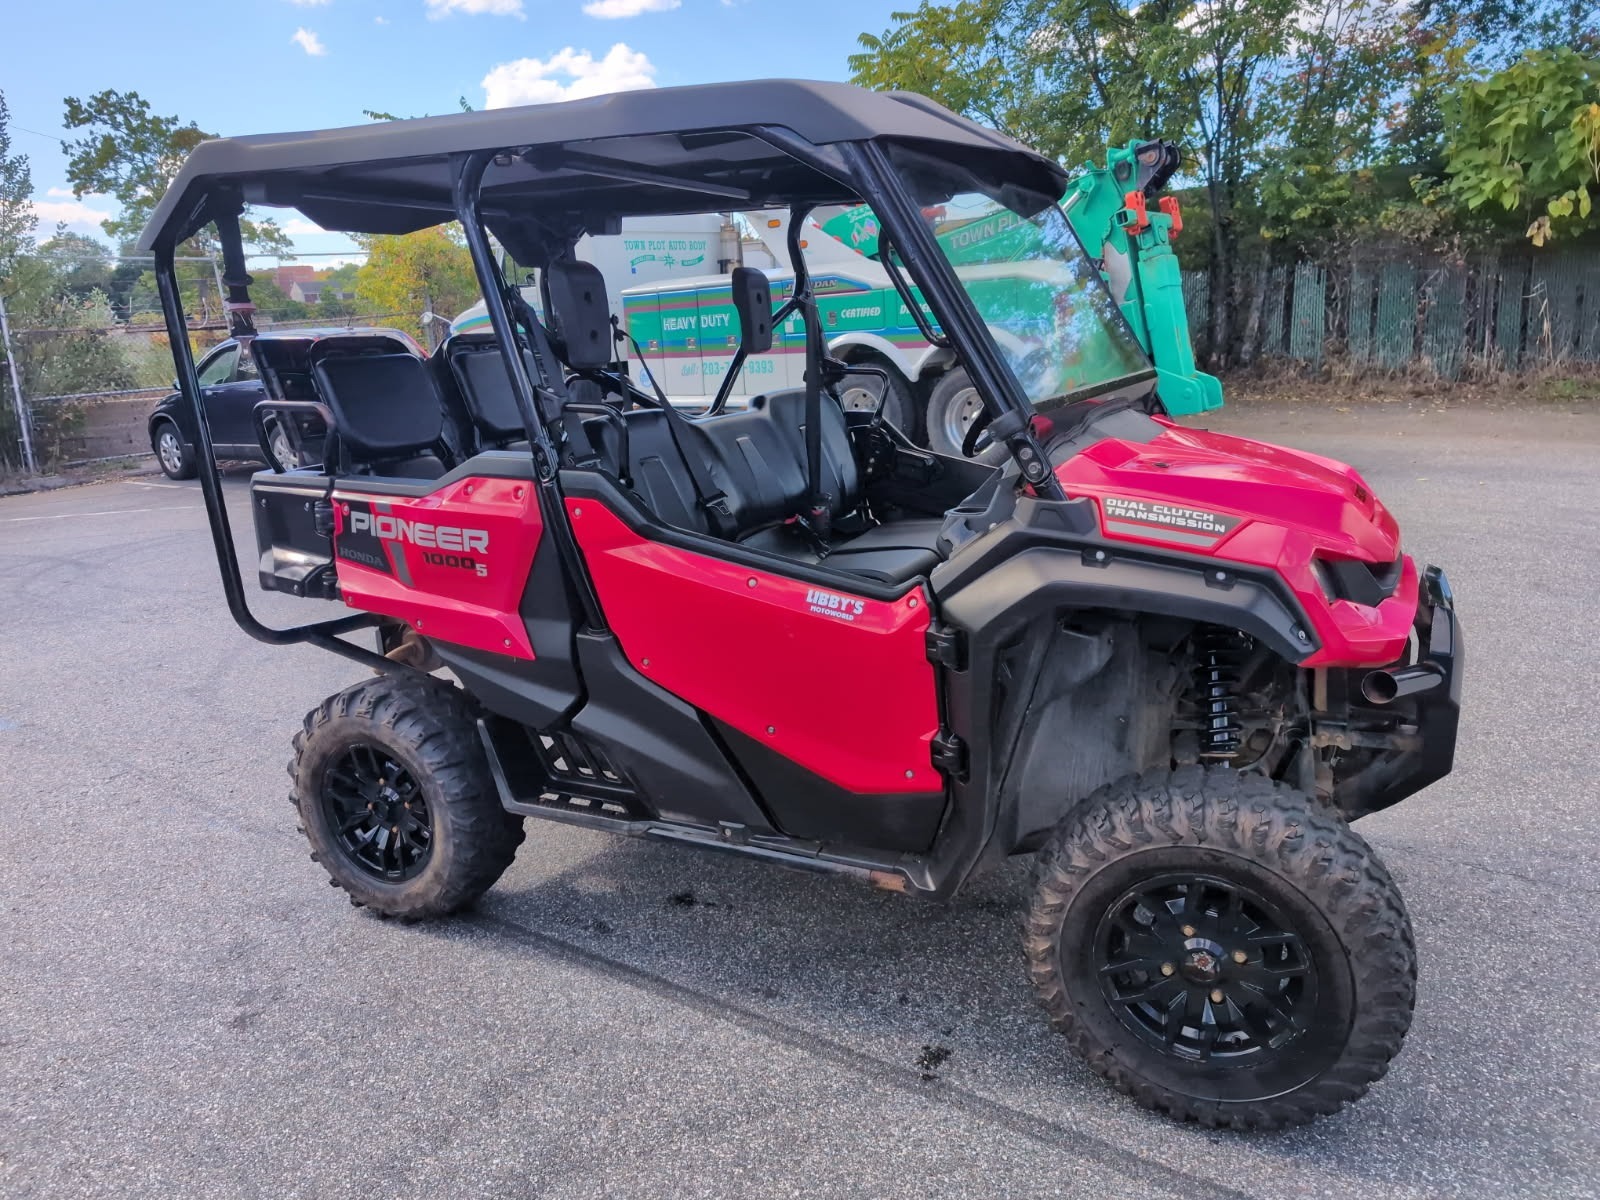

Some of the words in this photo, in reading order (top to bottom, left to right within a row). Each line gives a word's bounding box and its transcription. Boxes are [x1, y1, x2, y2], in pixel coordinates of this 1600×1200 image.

[624, 239, 646, 251] TOWN
[648, 239, 666, 251] PLOT
[669, 239, 687, 251] AUTO
[688, 239, 707, 251] BODY
[950, 222, 995, 249] TOWN
[663, 316, 697, 331] HEAVY
[701, 313, 730, 328] DUTY
[840, 306, 881, 318] CERTIFIED
[702, 360, 774, 375] 203-7-9393
[1106, 498, 1147, 511] DUAL
[1152, 505, 1214, 522] CLUTCH
[1106, 506, 1226, 533] TRANSMISSION
[351, 511, 489, 554] PIONEER
[340, 547, 385, 567] HONDA
[806, 589, 865, 615] LIBBY'S
[810, 605, 854, 621] MOTOWORLD
